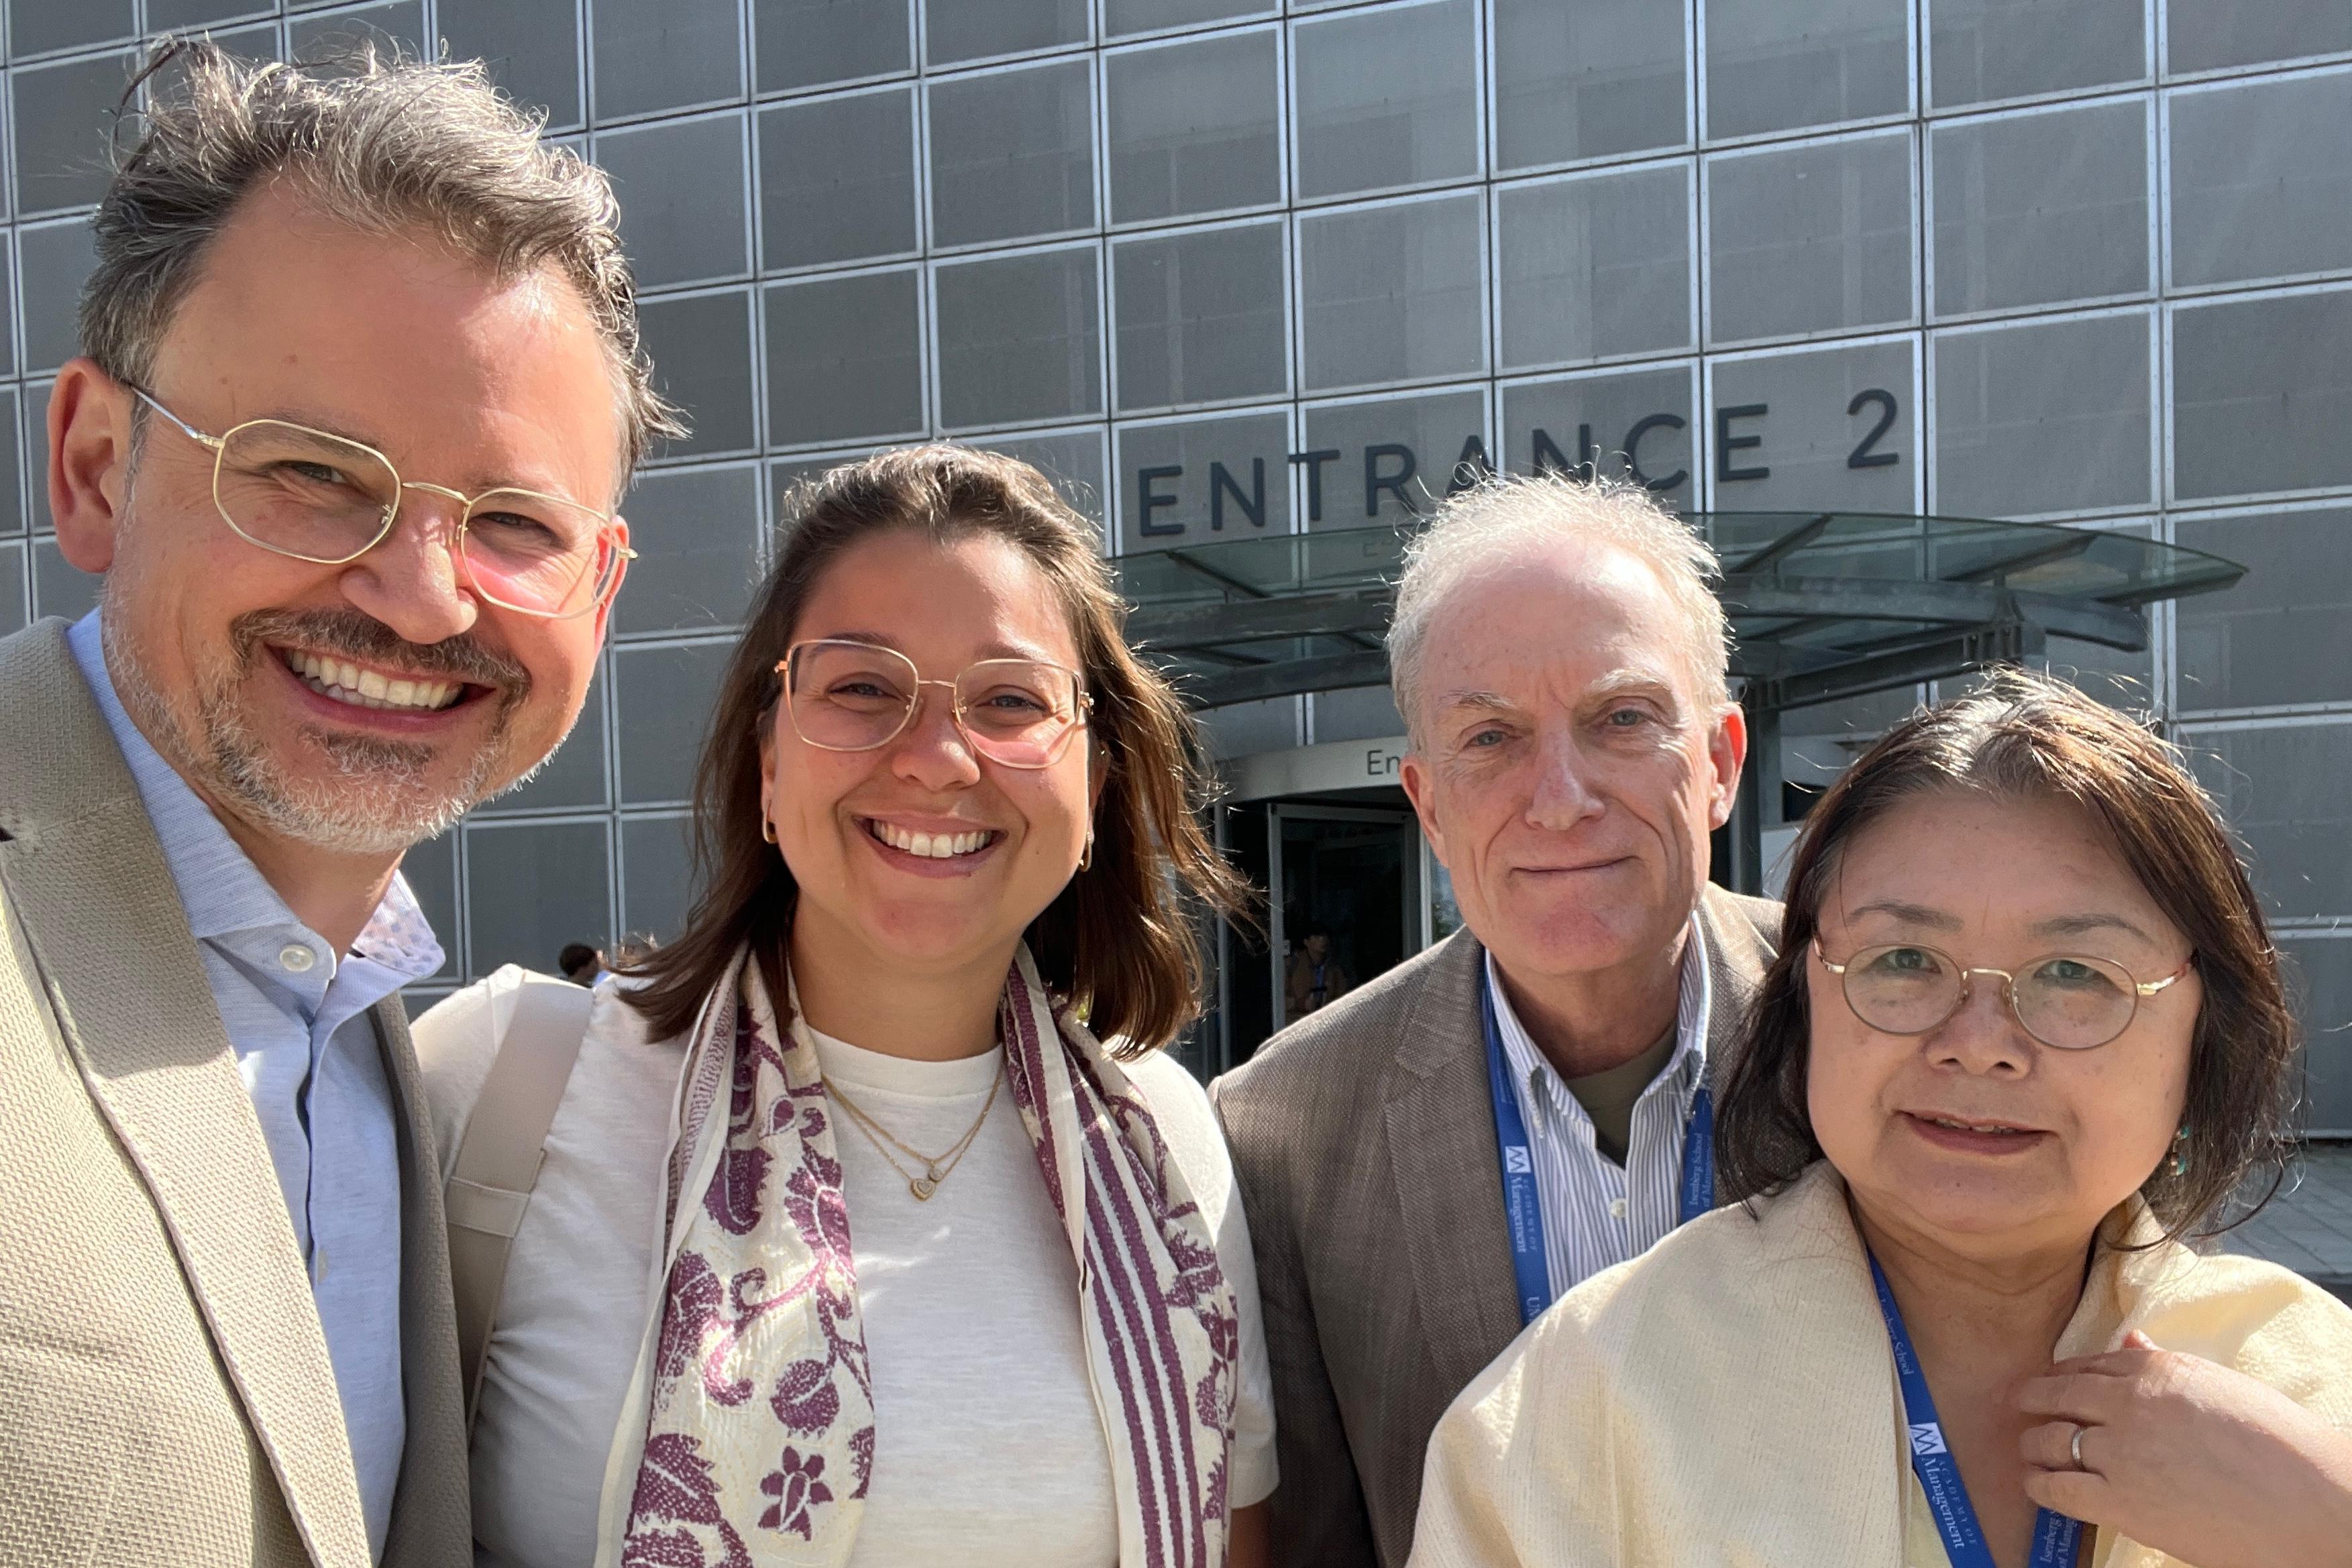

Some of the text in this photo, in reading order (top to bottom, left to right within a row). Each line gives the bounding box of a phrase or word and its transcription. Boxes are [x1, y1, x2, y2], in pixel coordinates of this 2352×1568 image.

[1138, 389, 1899, 537] ENTRANCE 2
[1921, 1457, 1964, 1549] Management
